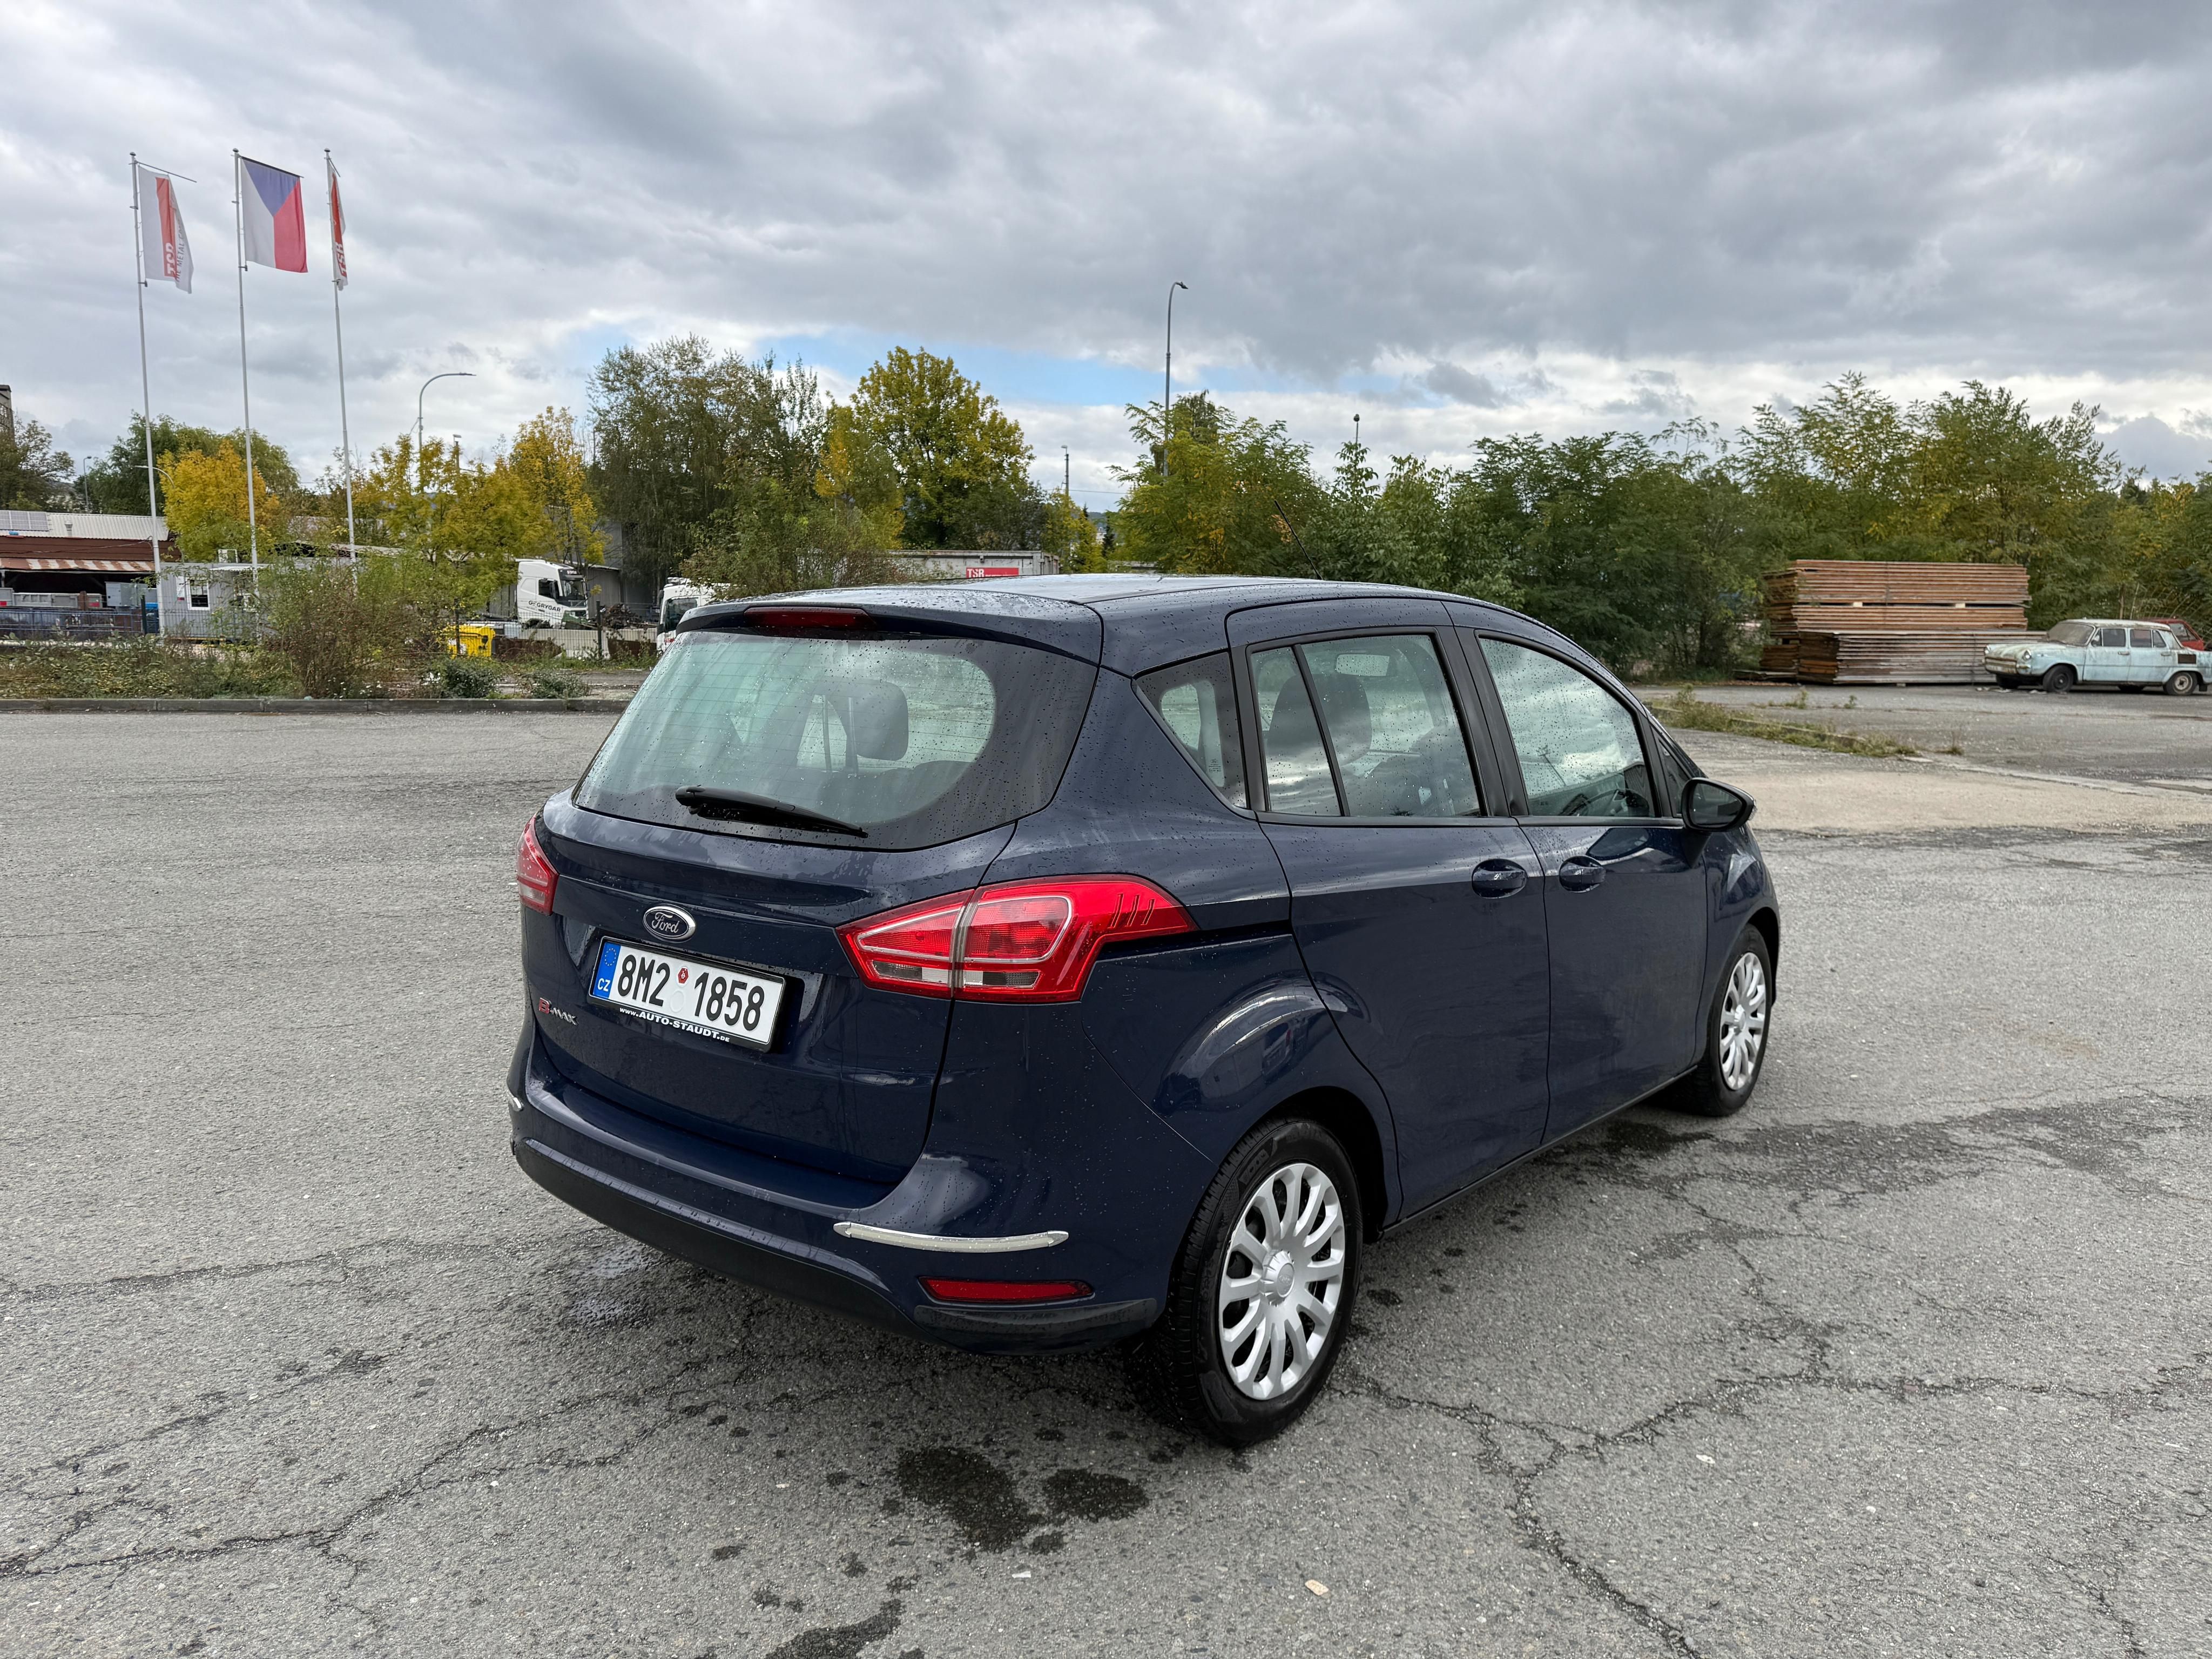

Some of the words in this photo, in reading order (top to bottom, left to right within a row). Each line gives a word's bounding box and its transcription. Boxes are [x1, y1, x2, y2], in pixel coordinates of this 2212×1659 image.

[967, 569, 984, 577] TSR
[651, 912, 680, 933] Ford
[597, 978, 611, 992] CZ
[617, 954, 670, 1007] 8M2
[694, 972, 765, 1031] 1858
